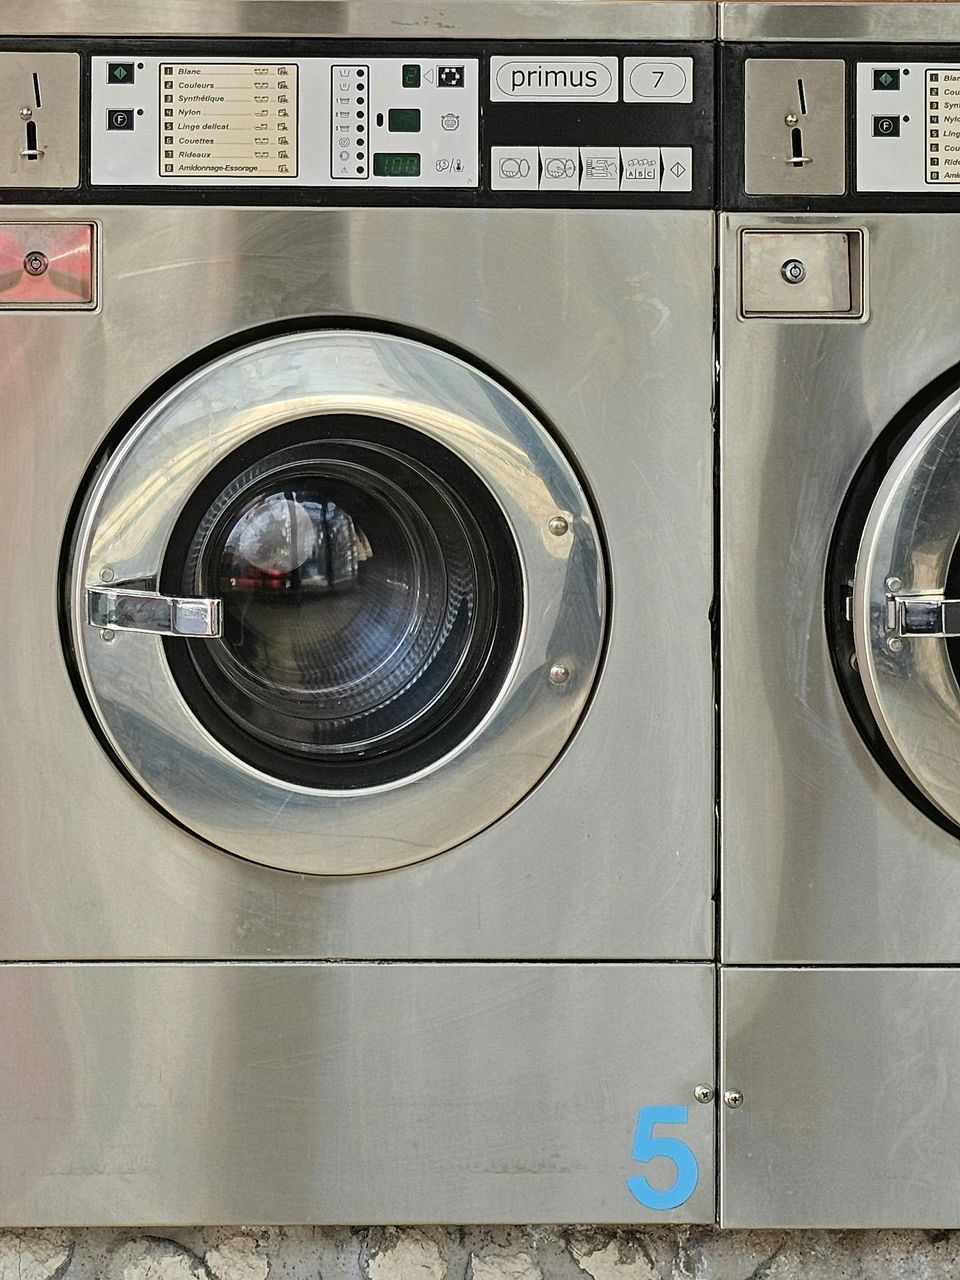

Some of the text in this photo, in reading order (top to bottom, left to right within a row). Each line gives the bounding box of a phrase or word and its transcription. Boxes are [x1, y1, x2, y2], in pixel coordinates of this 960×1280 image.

[405, 67, 417, 84] 2
[512, 65, 597, 92] primus
[652, 71, 664, 88] 7
[178, 95, 225, 103] Synthétique
[177, 123, 200, 131] Linge
[943, 130, 960, 139] Ling
[626, 1105, 699, 1211] 5
